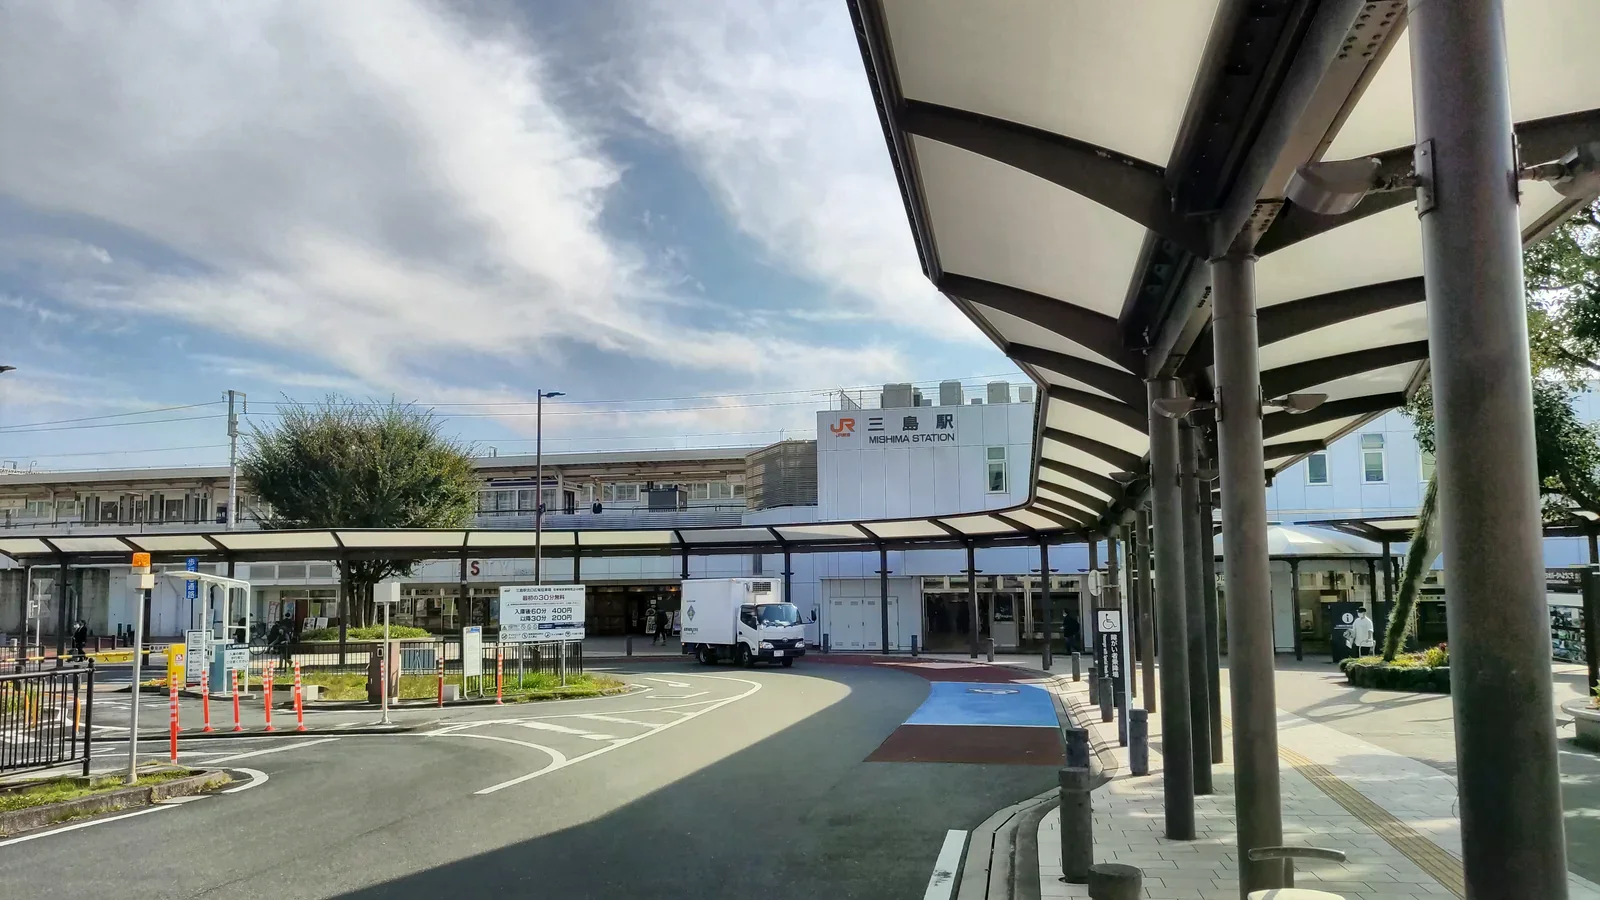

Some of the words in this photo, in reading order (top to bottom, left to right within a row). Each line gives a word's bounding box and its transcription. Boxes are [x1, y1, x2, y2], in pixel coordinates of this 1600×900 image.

[830, 418, 855, 432] JR
[867, 414, 954, 432] 三島駅
[868, 435, 910, 444] MISHIMA
[912, 433, 955, 443] STATION
[187, 558, 195, 599] 歩行通路
